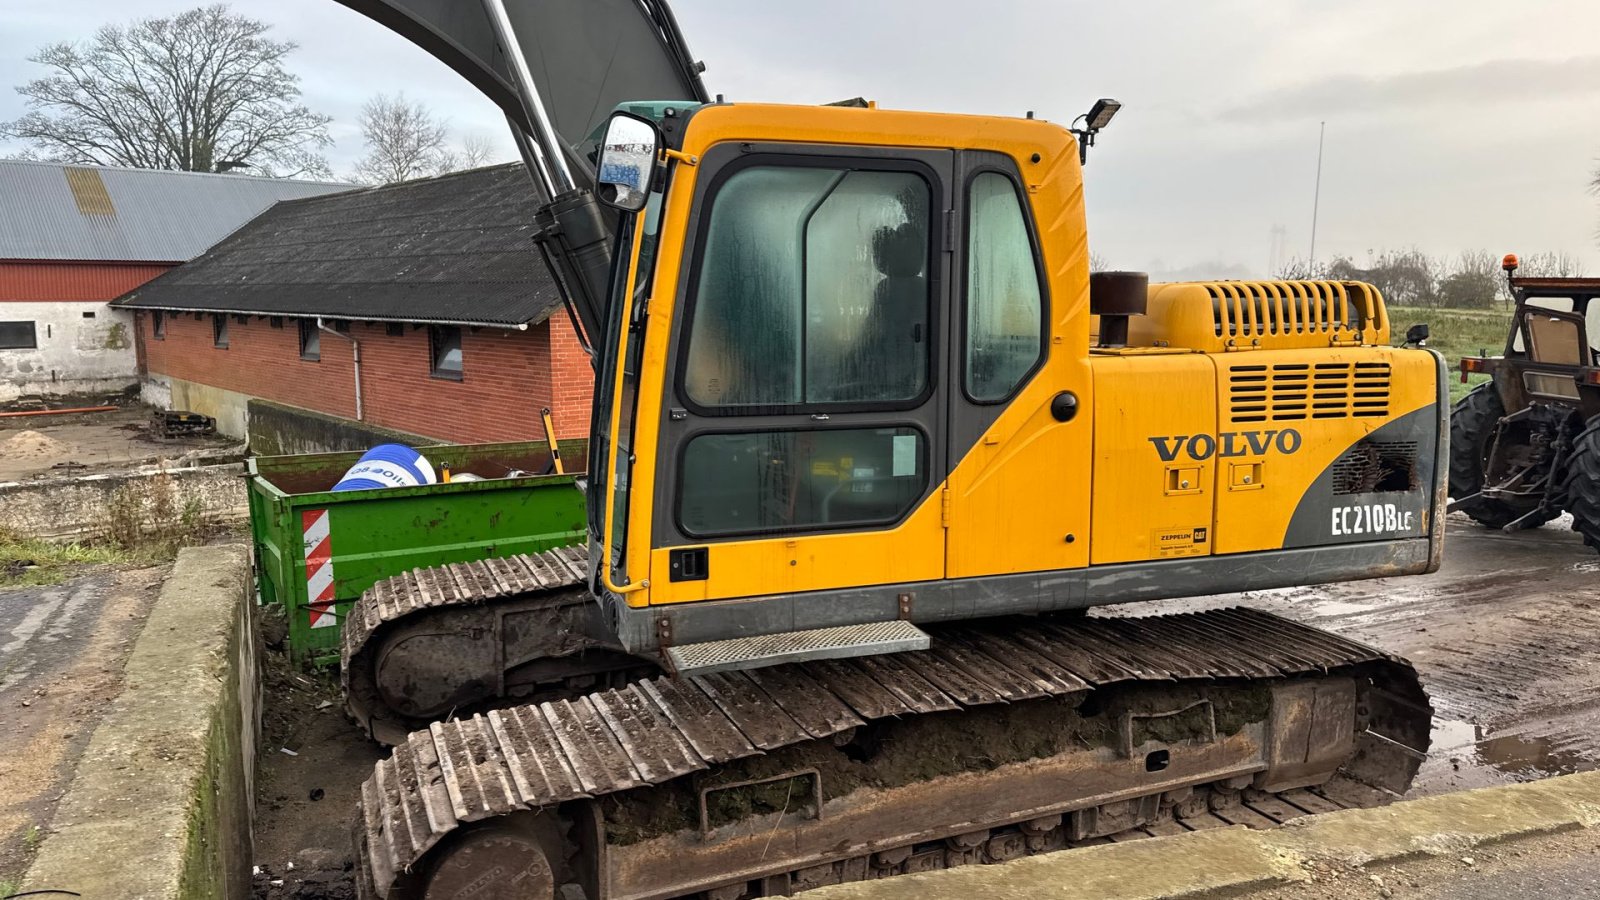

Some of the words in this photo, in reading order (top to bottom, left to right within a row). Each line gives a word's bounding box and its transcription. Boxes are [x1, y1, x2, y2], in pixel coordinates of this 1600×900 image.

[1148, 428, 1302, 462] VOLVO
[1160, 533, 1192, 541] ZEPPELIN
[1194, 531, 1206, 540] CAT
